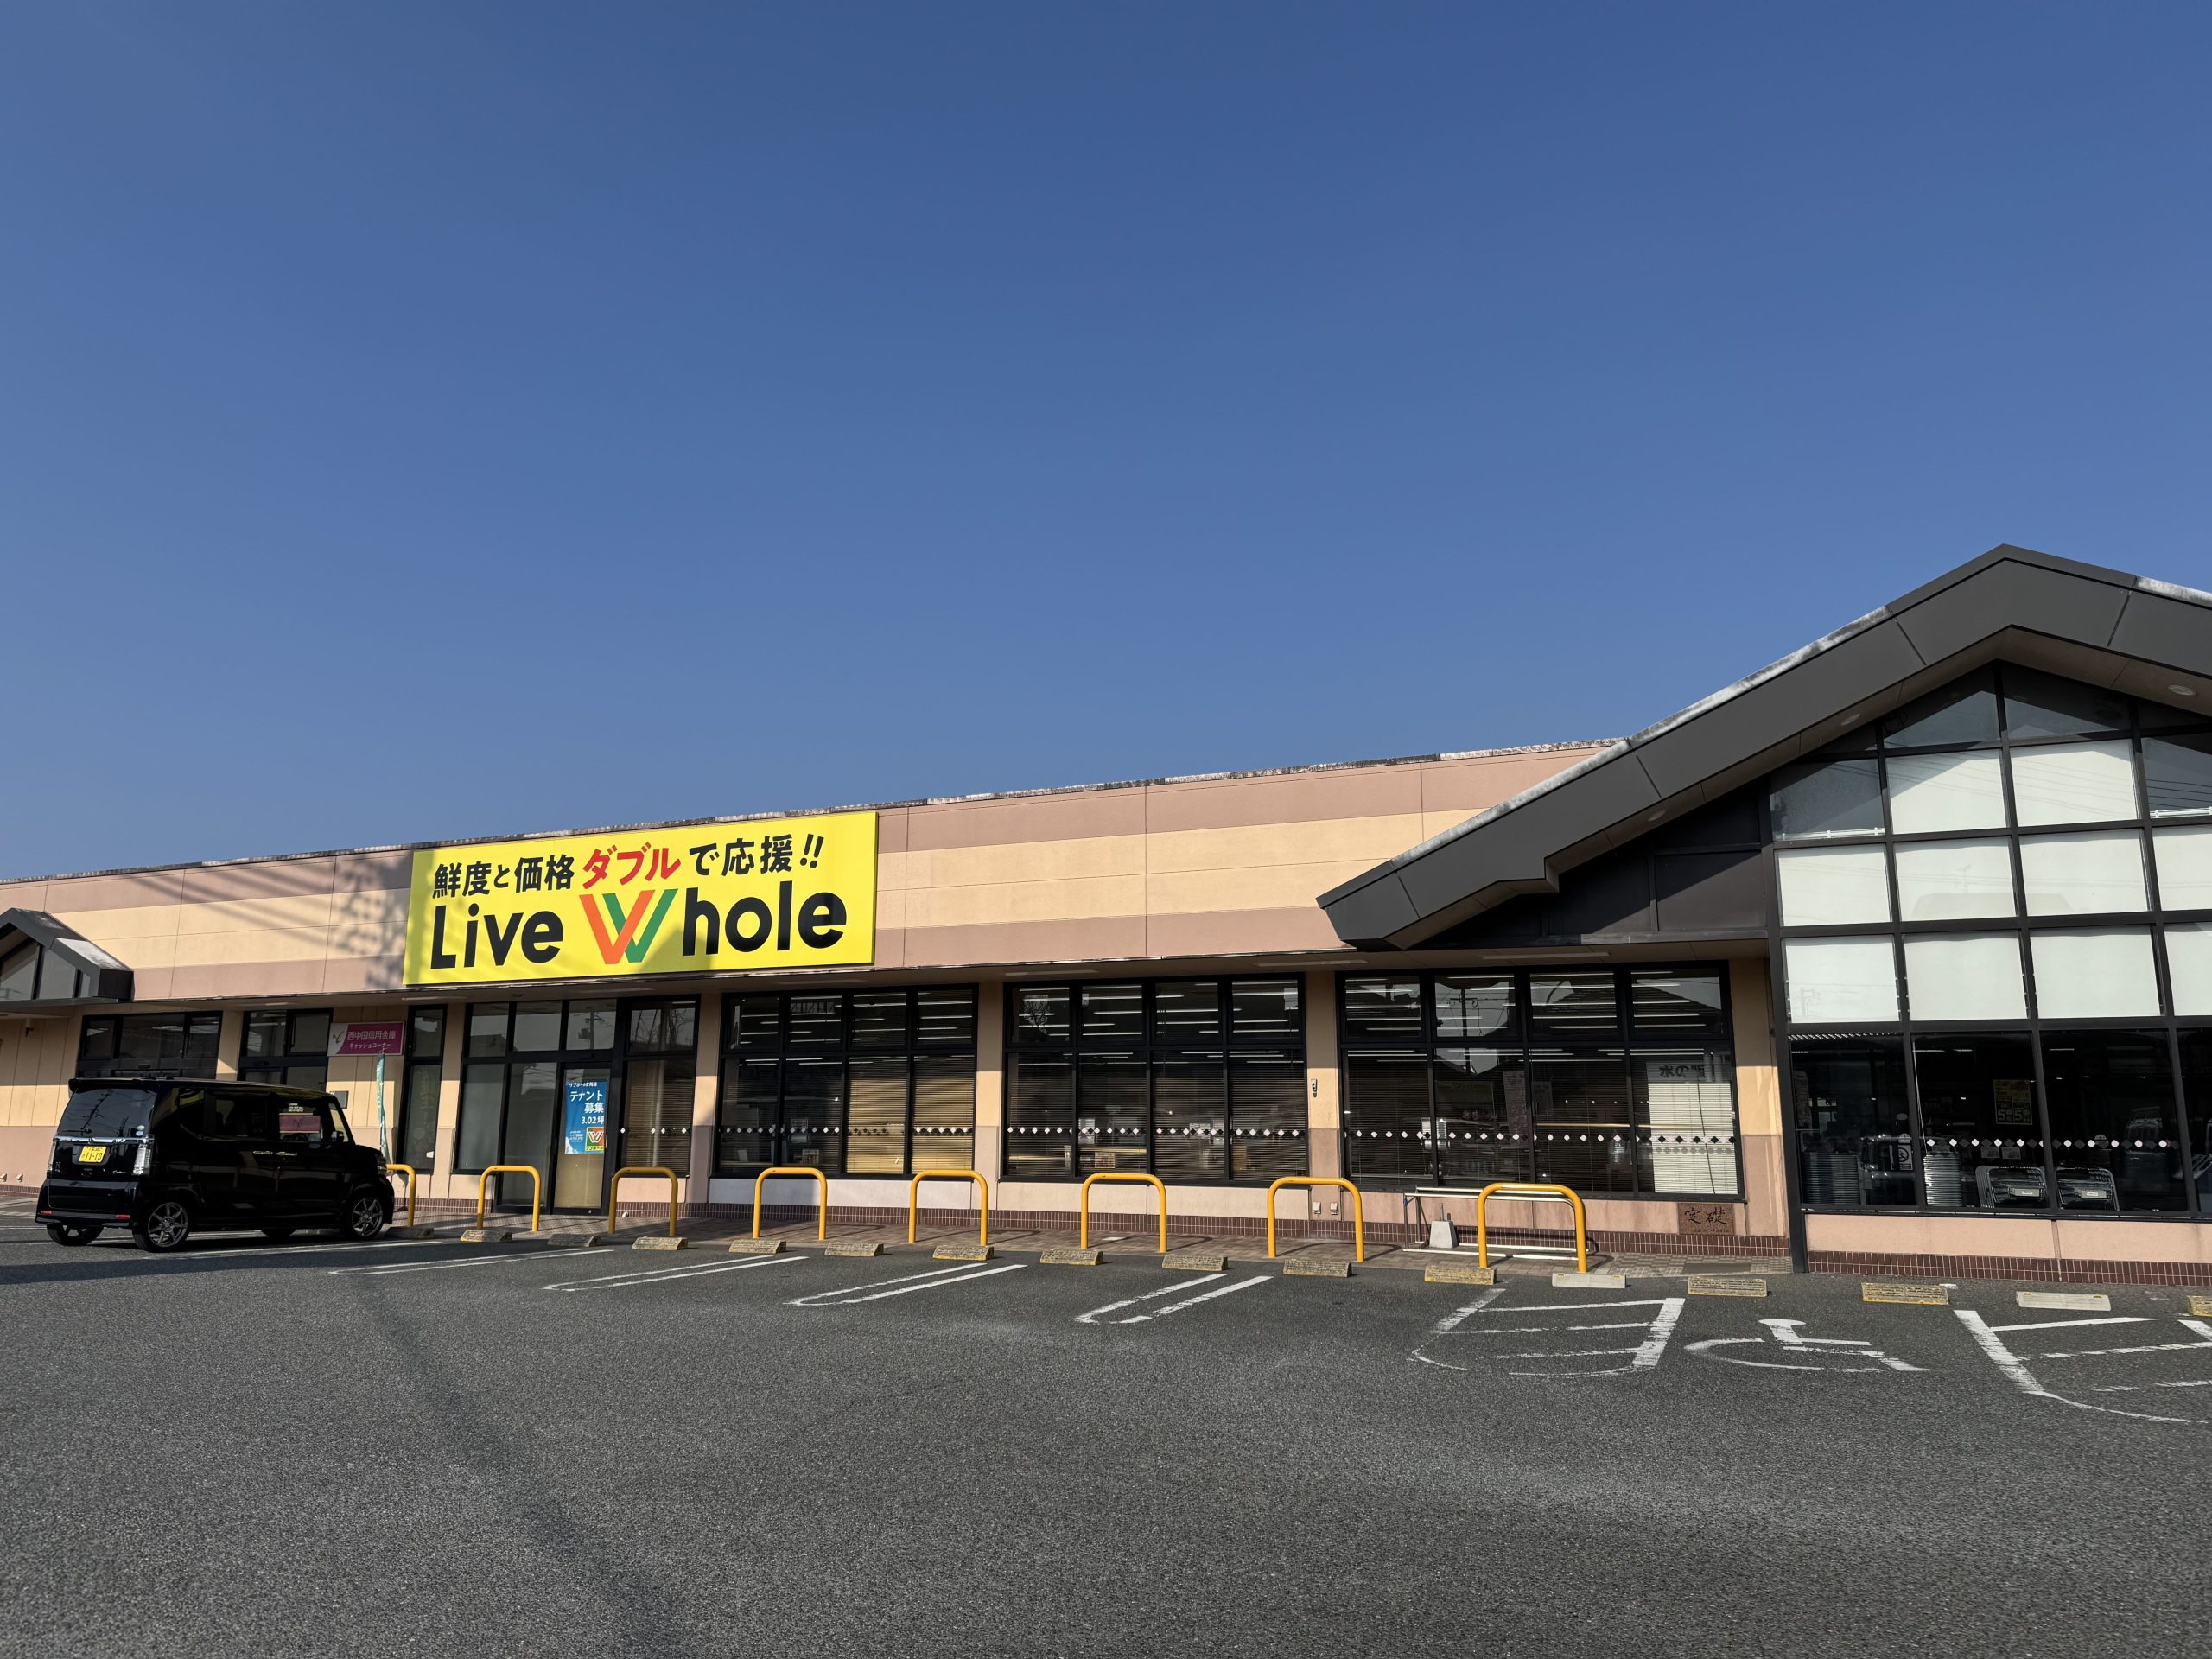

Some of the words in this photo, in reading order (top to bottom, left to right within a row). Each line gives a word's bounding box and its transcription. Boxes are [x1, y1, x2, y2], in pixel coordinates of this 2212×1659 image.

[431, 903, 564, 969] Live
[579, 880, 847, 965] Whole
[347, 1030, 397, 1041] 西中国信用金庫
[569, 1090, 603, 1102] テナント
[584, 1102, 604, 1114] 募集
[581, 1116, 605, 1125] 3.02坪
